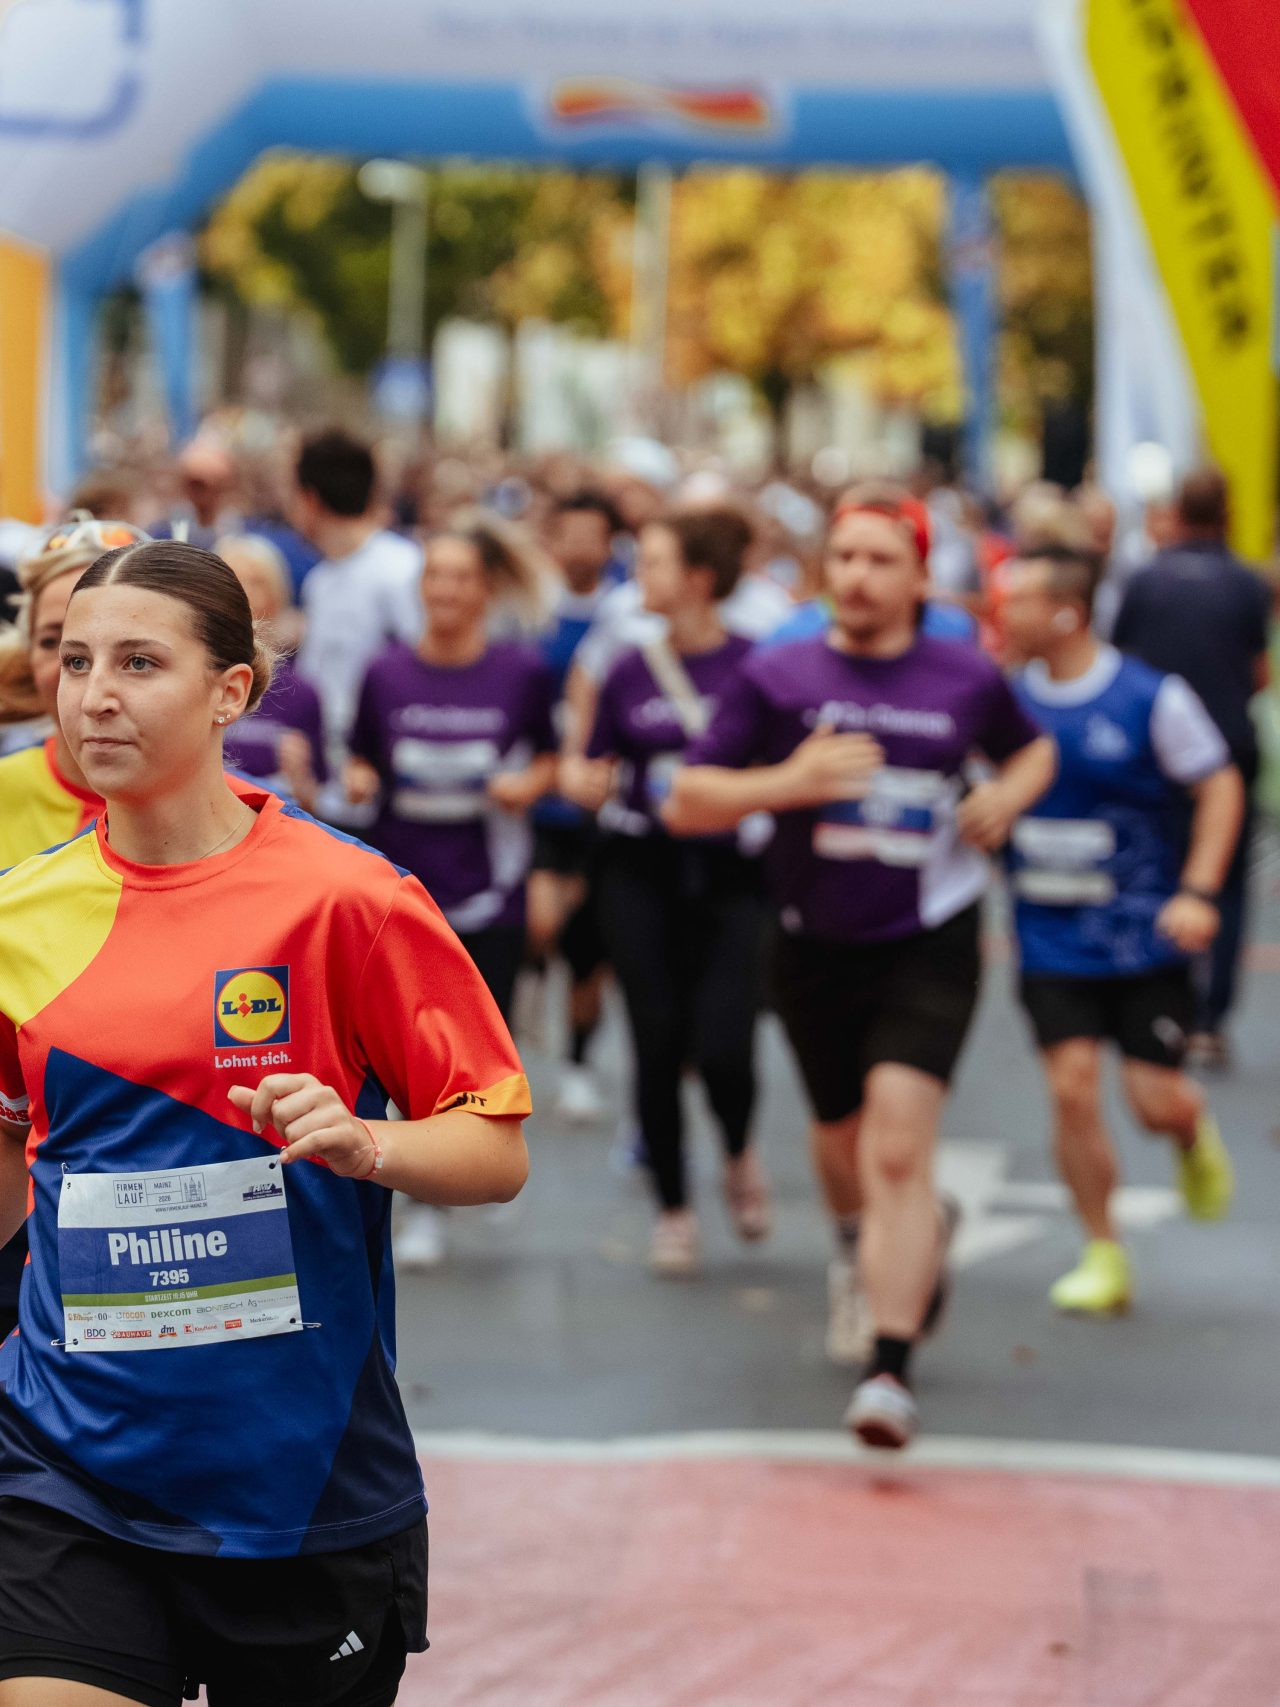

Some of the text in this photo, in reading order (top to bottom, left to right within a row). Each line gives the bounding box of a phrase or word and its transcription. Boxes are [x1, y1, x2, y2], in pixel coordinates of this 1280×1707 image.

[214, 1050, 292, 1069] Lohnt sich.
[116, 1183, 143, 1191] FIRMEN
[153, 1181, 172, 1189] MAINZ
[117, 1192, 144, 1205] LAUF
[107, 1228, 228, 1266] Philine
[149, 1268, 190, 1287] 7395
[86, 1328, 106, 1337] BDO
[160, 1325, 175, 1333] dm
